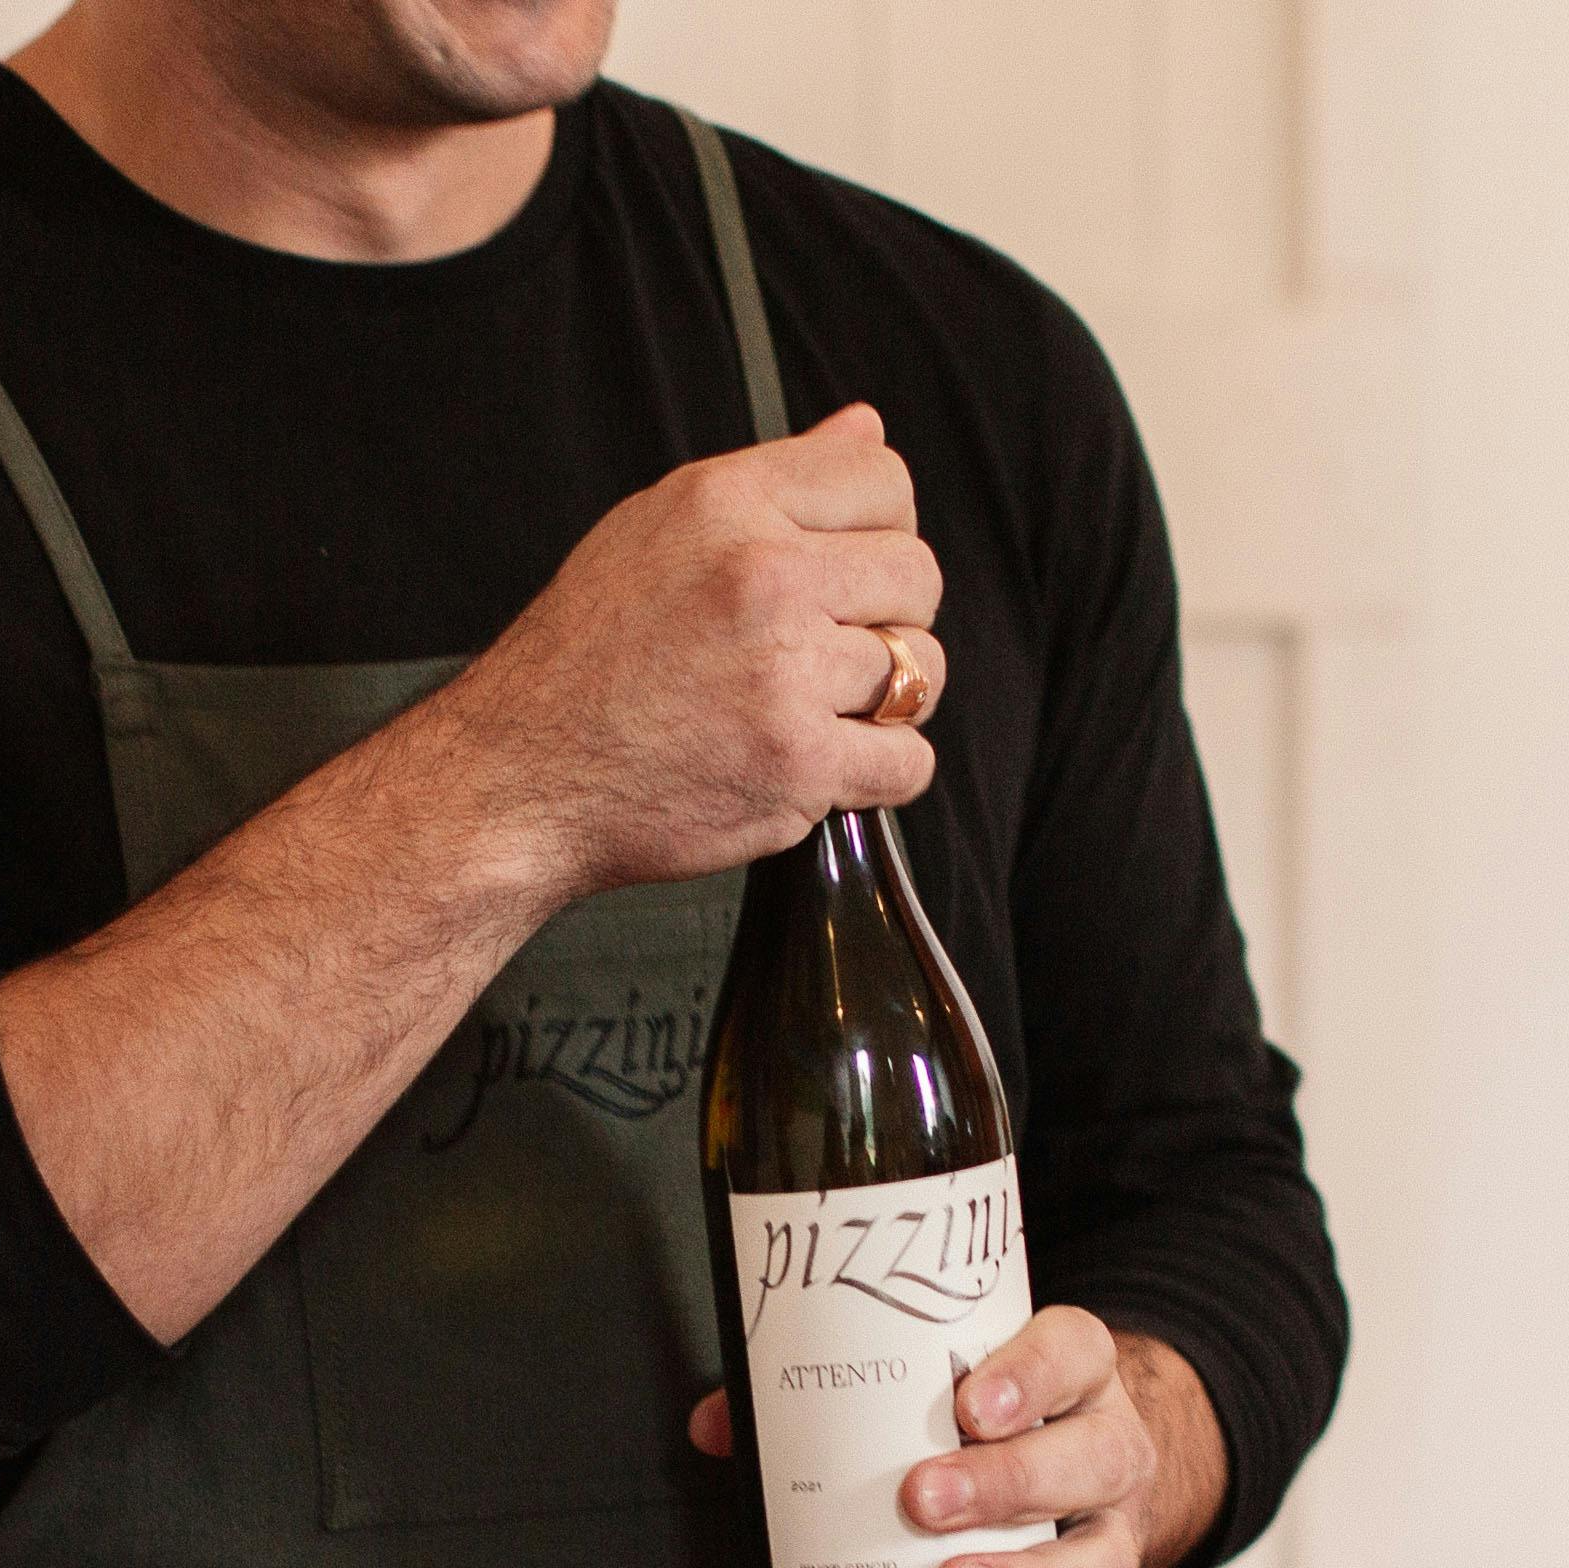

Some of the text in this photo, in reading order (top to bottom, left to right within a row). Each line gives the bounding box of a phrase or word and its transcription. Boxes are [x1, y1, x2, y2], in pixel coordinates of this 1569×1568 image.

[420, 984, 704, 1152] pizzini
[746, 1158, 1025, 1340] pizzini
[779, 1357, 909, 1392] ATTENTO
[790, 1479, 824, 1494] 2021
